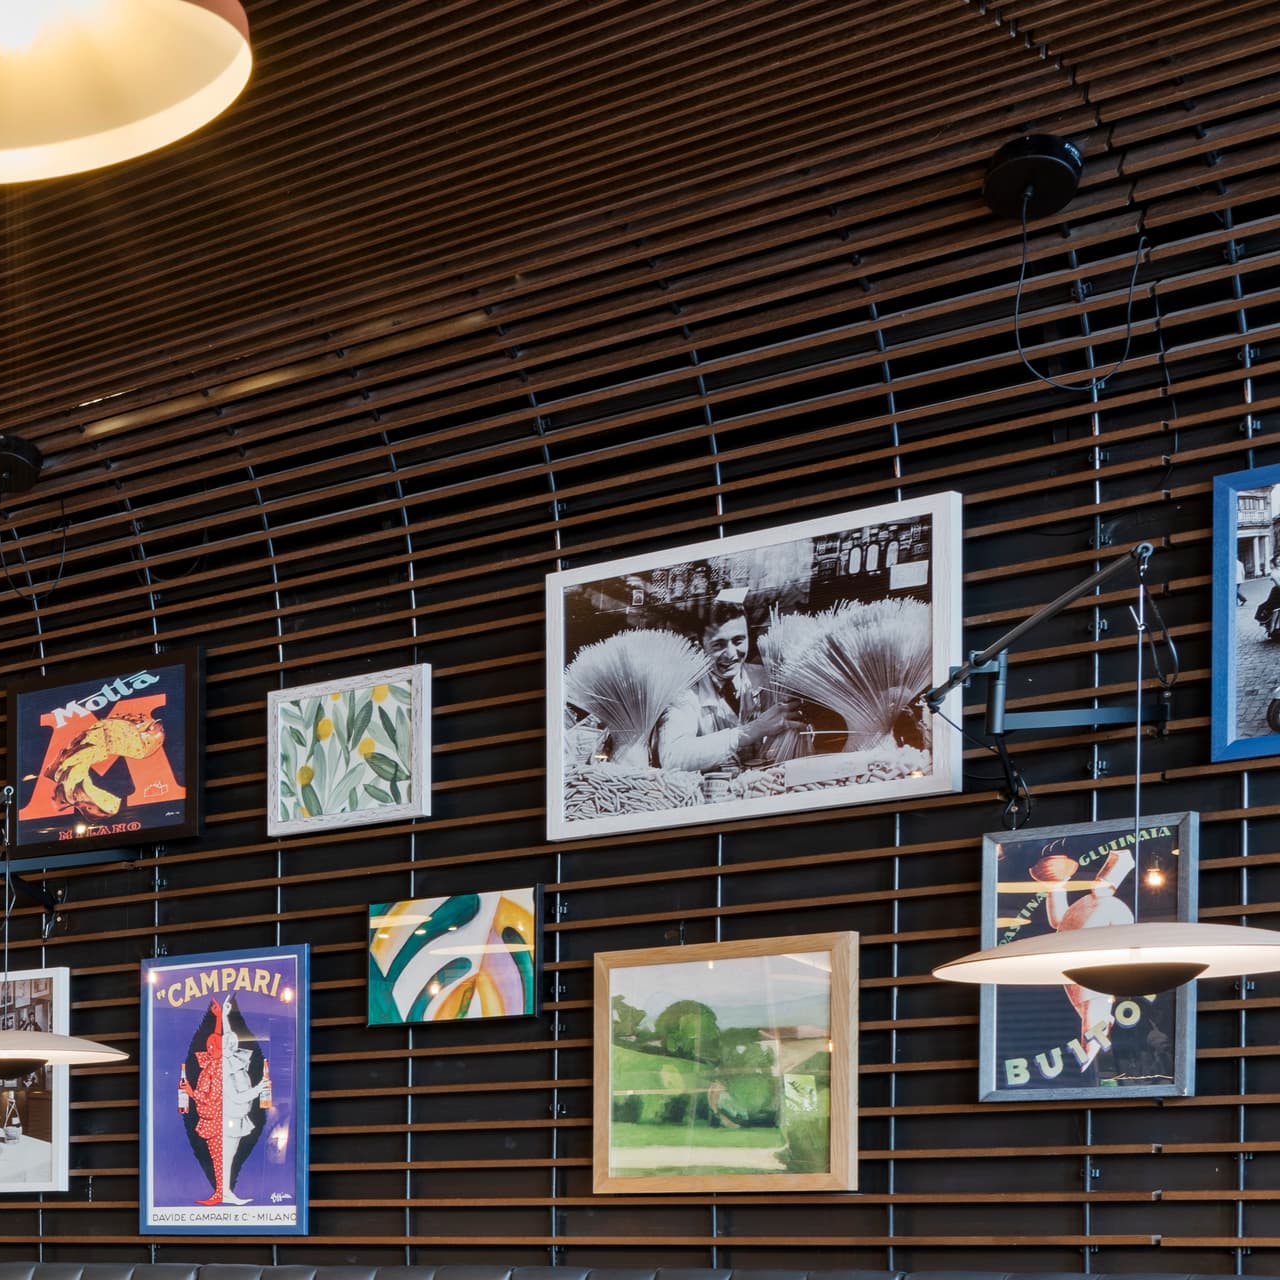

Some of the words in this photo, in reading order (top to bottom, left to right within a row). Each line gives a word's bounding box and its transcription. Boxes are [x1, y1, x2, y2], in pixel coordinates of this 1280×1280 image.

[51, 670, 160, 728] Motta
[1078, 826, 1171, 866] GLUTINATA
[1004, 994, 1157, 1088] BUITO
[152, 1213, 187, 1222] DAVIDE
[190, 1213, 232, 1222] CAMPARI
[257, 1213, 297, 1221] MILANO
